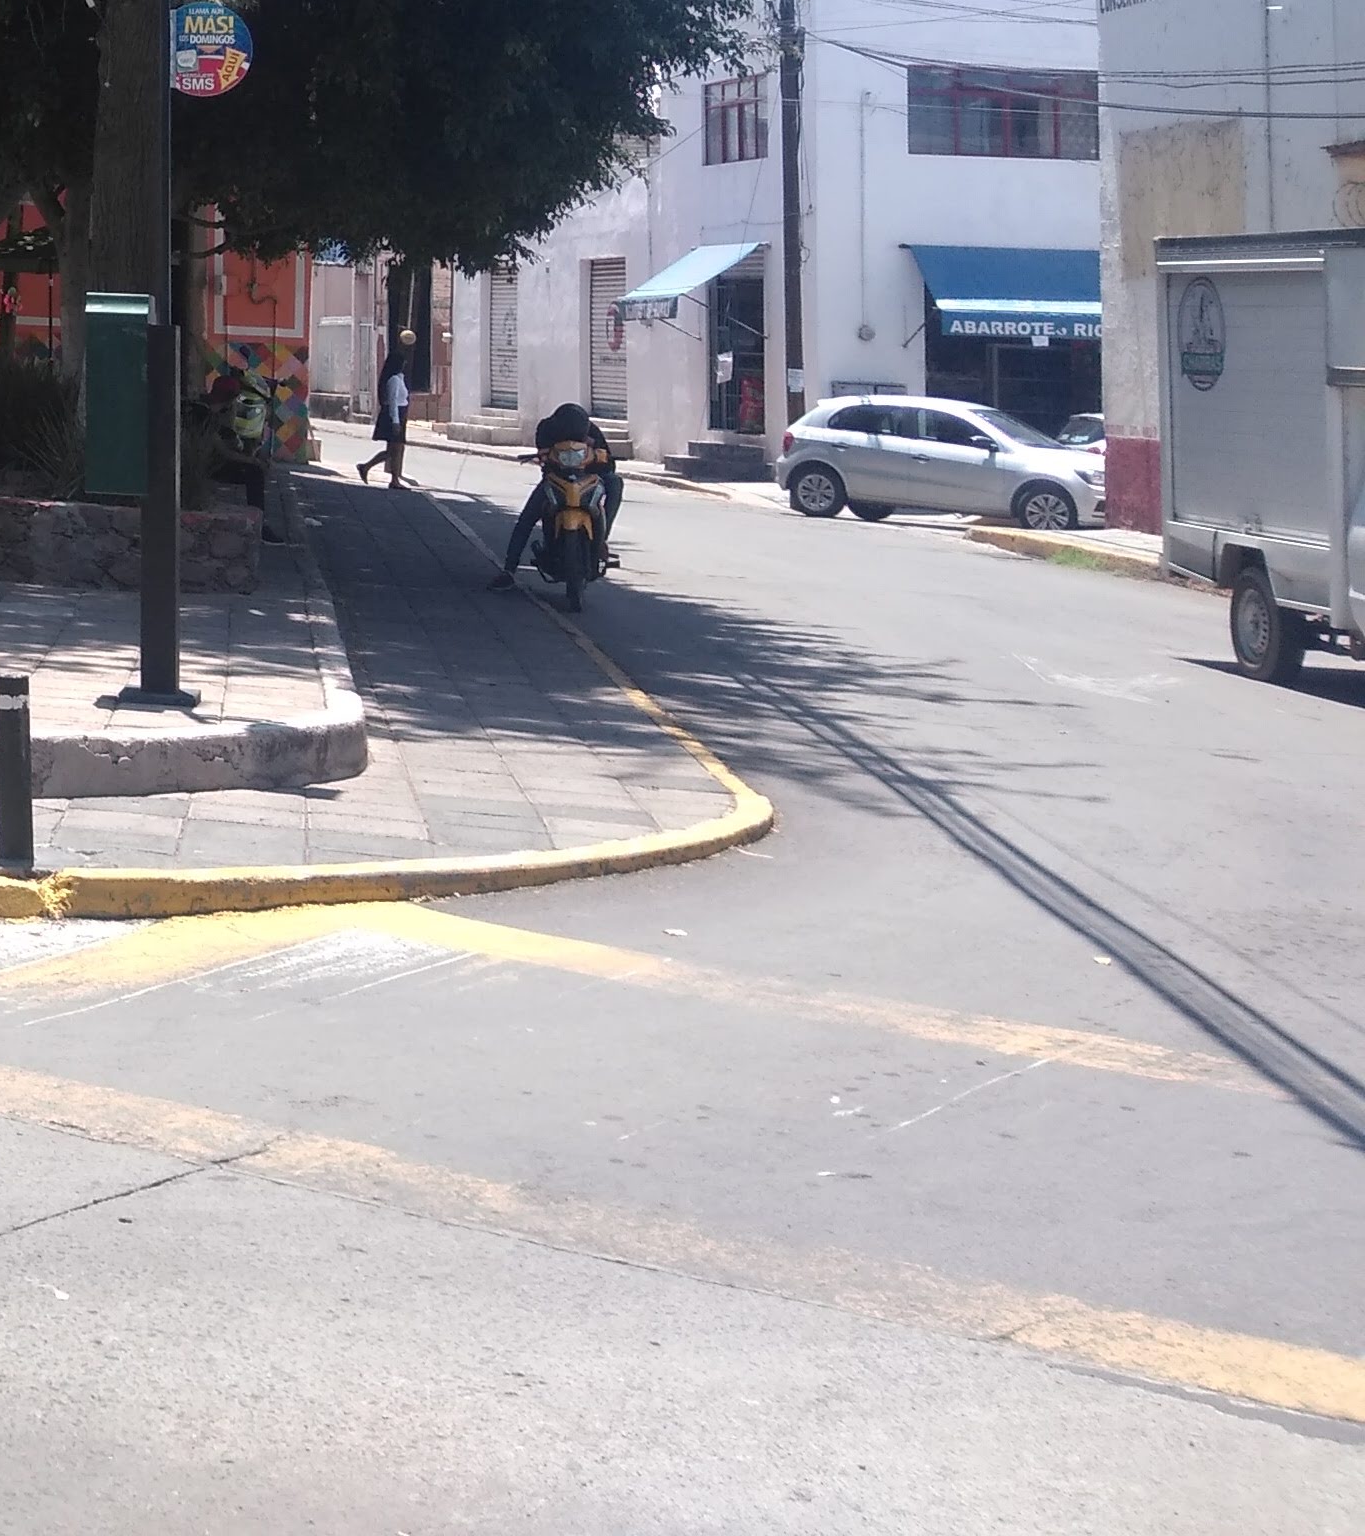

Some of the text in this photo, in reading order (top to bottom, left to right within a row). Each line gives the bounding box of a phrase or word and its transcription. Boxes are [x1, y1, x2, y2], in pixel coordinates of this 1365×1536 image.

[184, 14, 234, 34] MÁS!
[189, 34, 236, 44] DOMINGOS
[182, 77, 215, 91] SMS
